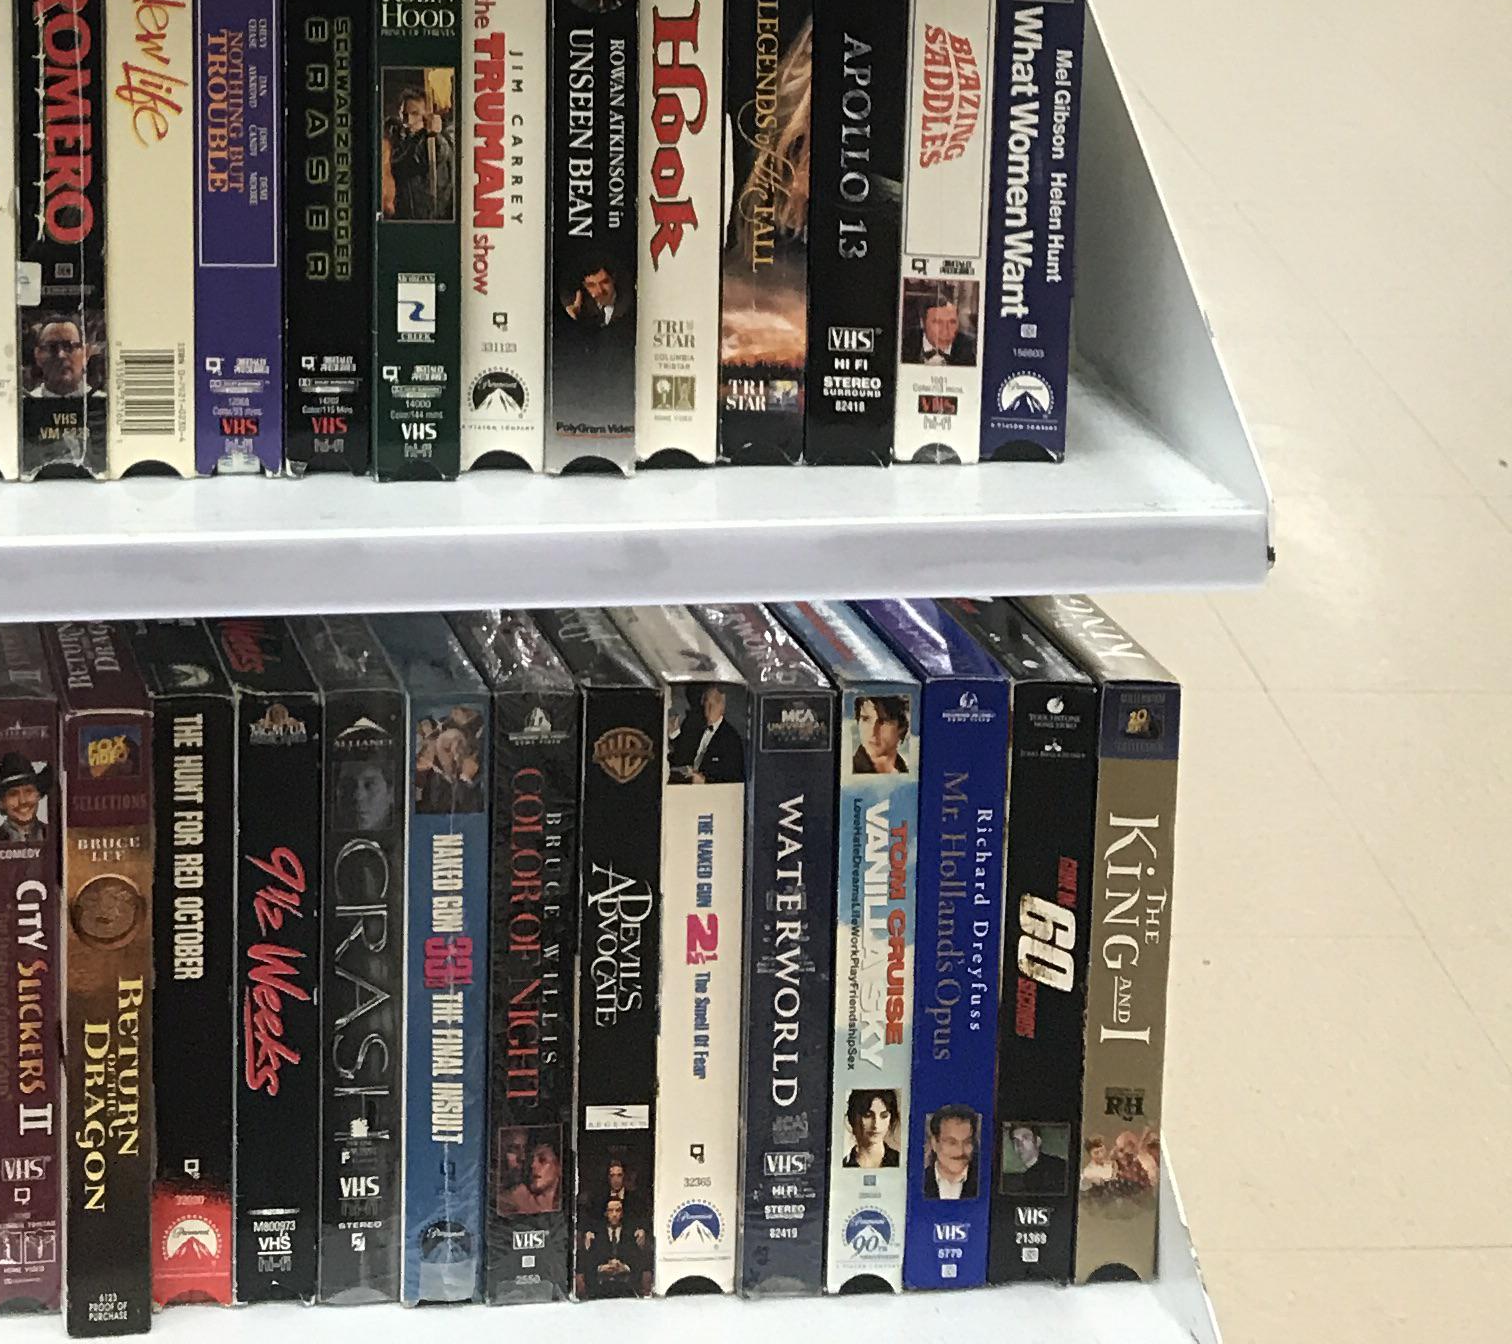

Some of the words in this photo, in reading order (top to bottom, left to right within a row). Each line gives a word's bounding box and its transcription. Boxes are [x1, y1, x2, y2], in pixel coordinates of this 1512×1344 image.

[381, 8, 455, 28] HOOD
[1010, 6, 1044, 97] What
[568, 29, 593, 147] UNSEEN
[838, 33, 871, 203] APOLLO
[568, 154, 594, 238] BEAN
[1005, 101, 1040, 227] Women
[839, 220, 867, 259] 13
[1001, 230, 1034, 319] Want
[174, 713, 203, 748] THE
[174, 755, 204, 804] HUNT
[174, 811, 204, 846] FOR
[174, 853, 204, 889] RED
[174, 896, 204, 980] OCTOBER
[770, 793, 807, 1108] WATERWORLD
